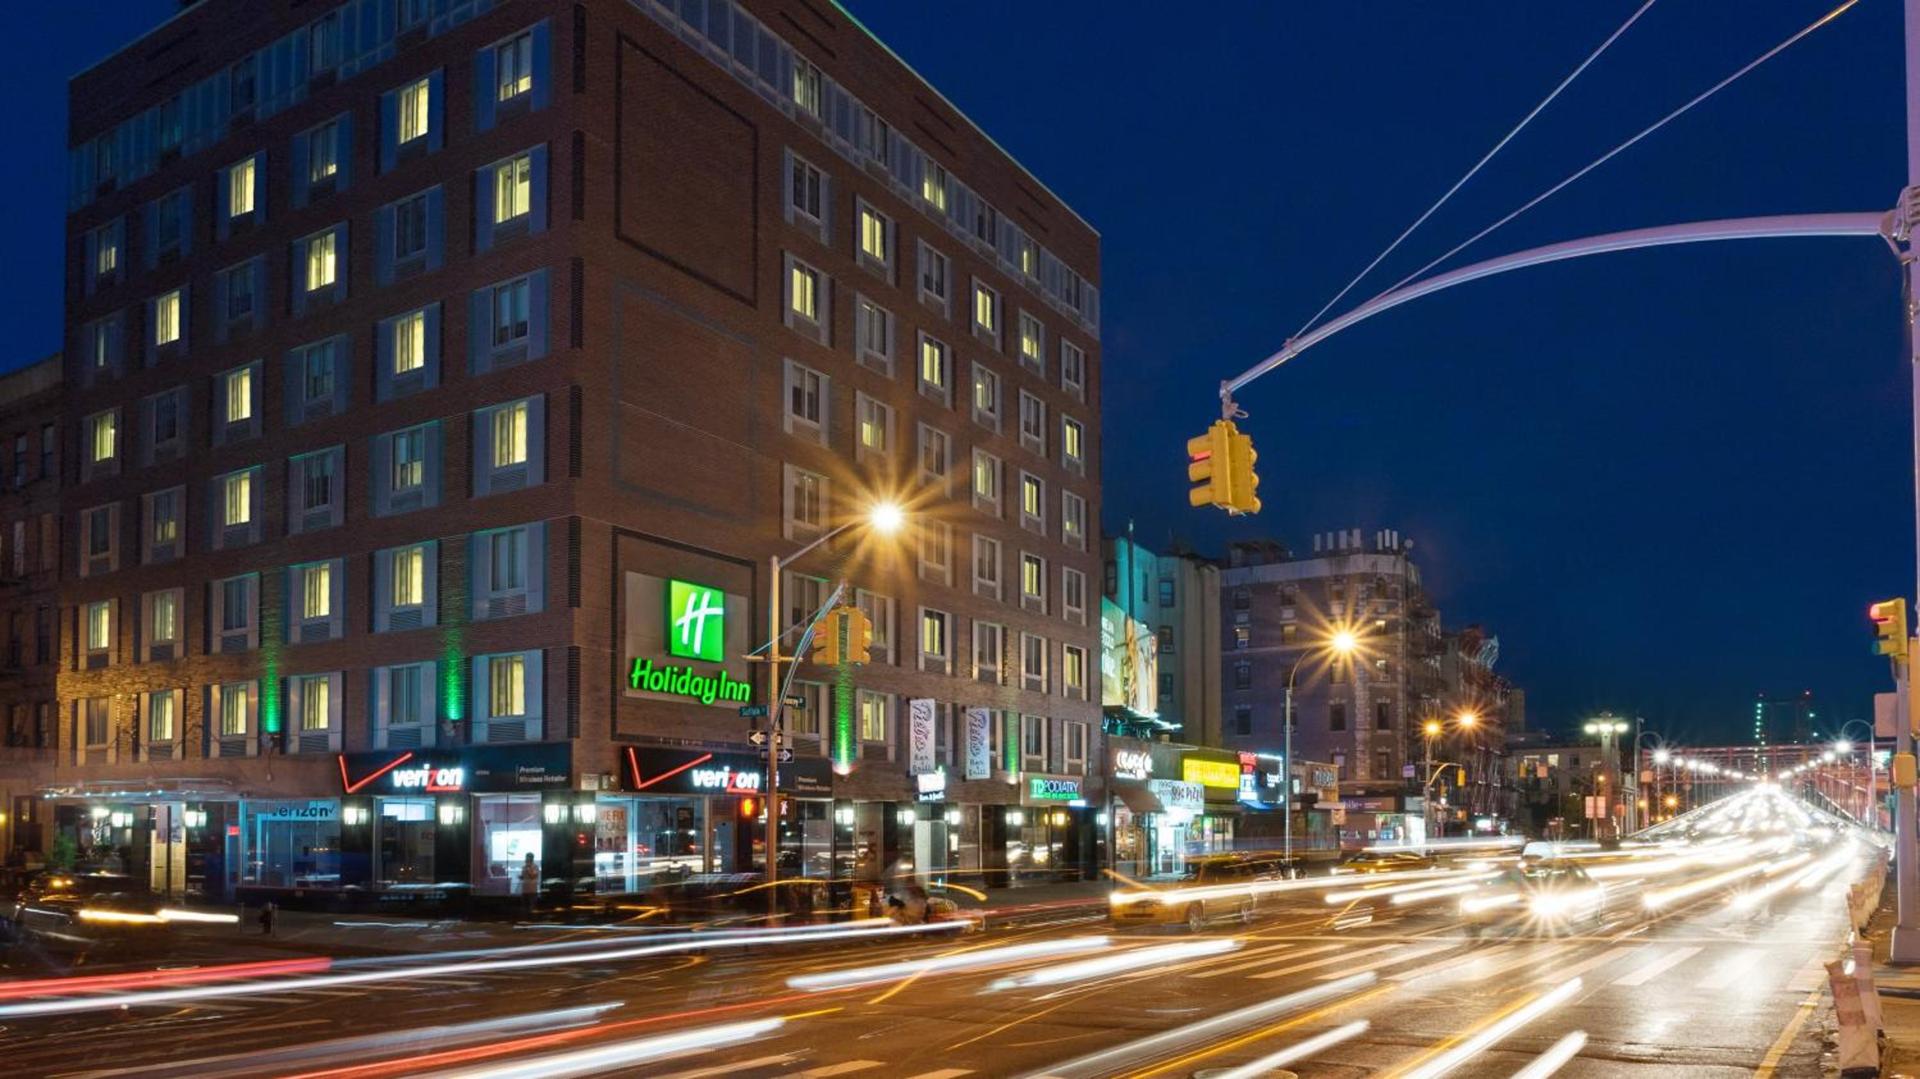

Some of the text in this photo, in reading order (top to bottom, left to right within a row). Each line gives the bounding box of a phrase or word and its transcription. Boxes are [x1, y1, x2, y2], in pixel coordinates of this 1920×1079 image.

[631, 657, 751, 704] Holiday Inn
[392, 764, 464, 793] verizon
[692, 766, 760, 794] verizon
